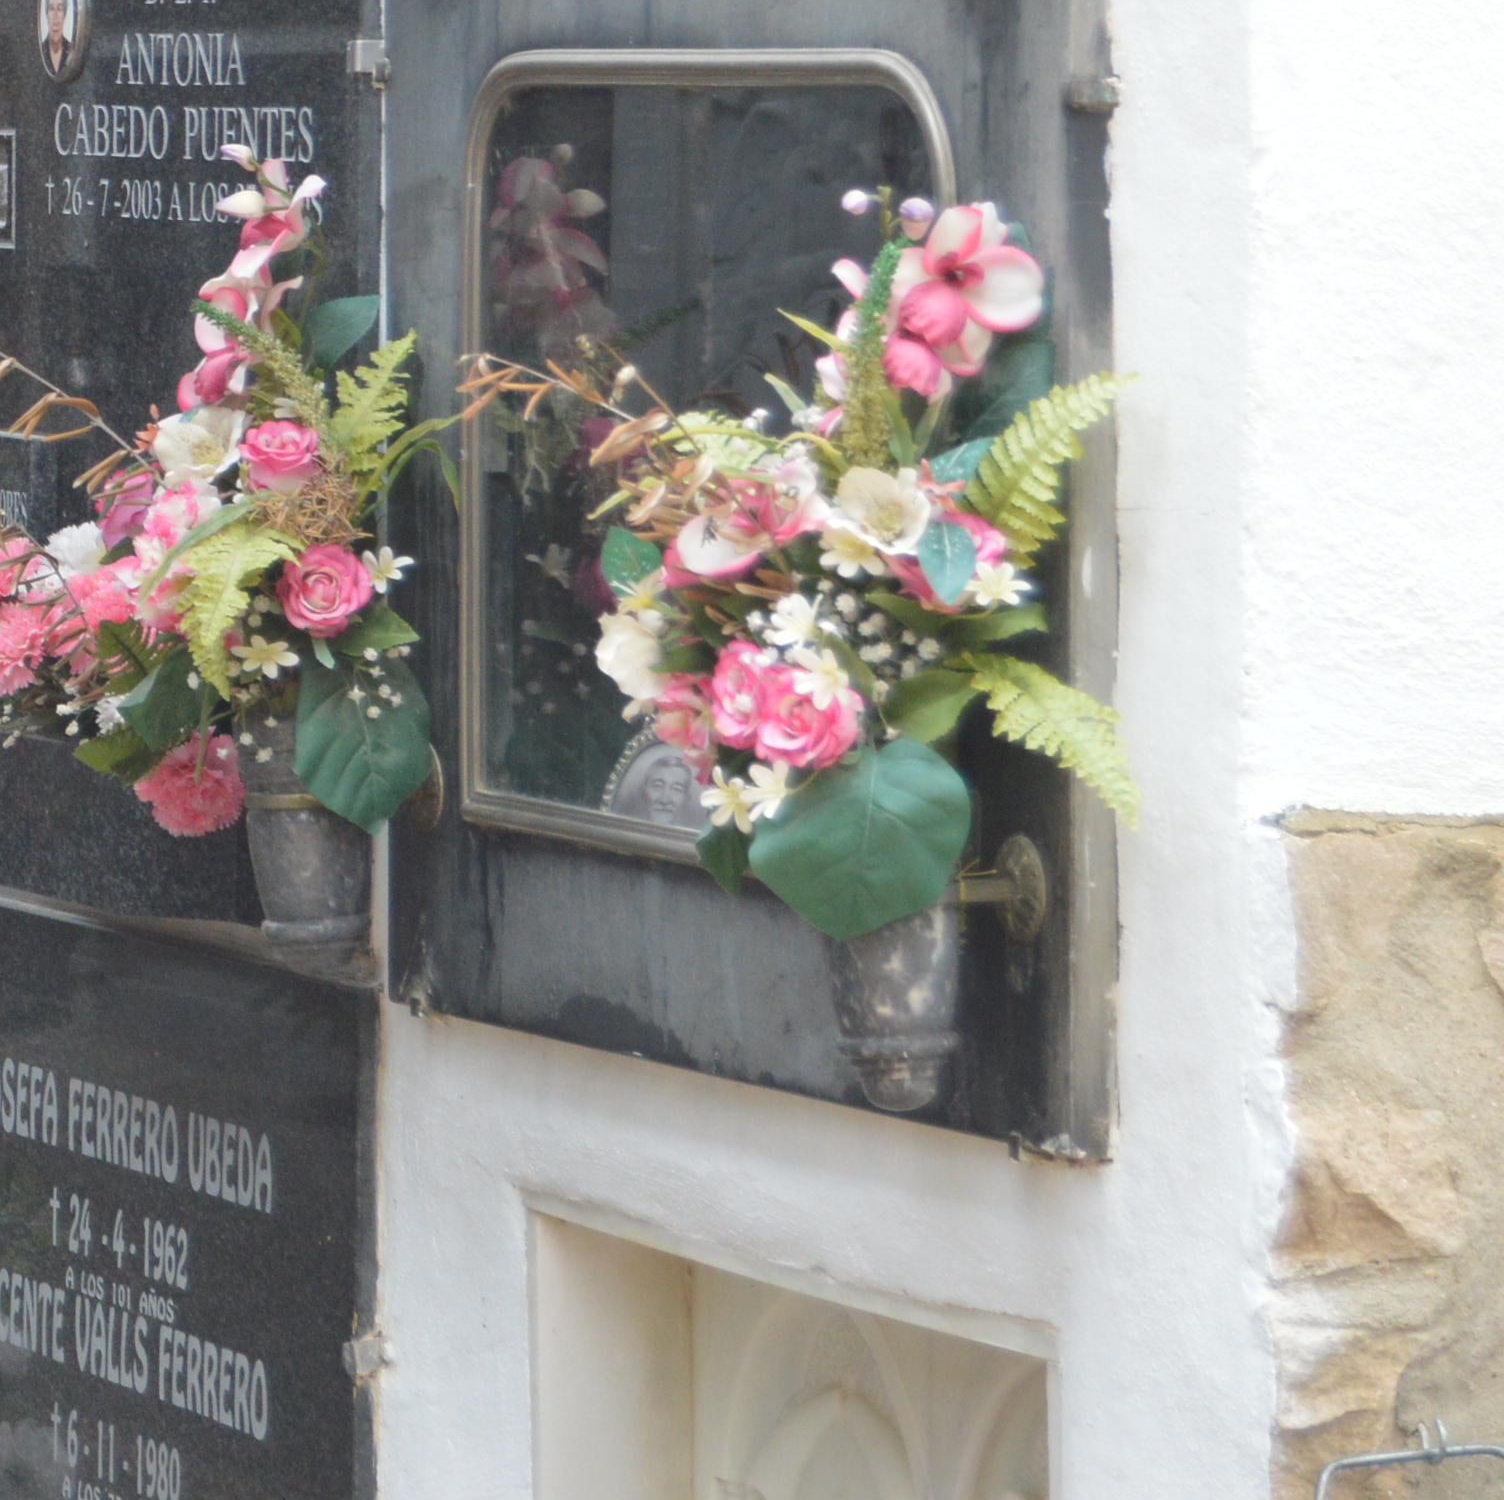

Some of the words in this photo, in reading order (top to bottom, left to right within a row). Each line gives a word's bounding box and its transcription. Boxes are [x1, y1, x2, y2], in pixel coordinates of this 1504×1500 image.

[116, 33, 245, 86] ANTONIA
[54, 103, 169, 160] CABEDO
[184, 107, 313, 163] PUENTES
[168, 182, 183, 221] A
[68, 1078, 180, 1184] FERRERO
[189, 1113, 273, 1215] UBEDA
[69, 1195, 91, 1257] 24
[143, 1218, 189, 1291] 1962
[65, 1267, 75, 1289] A
[81, 1269, 104, 1298] LOS
[112, 1283, 131, 1308] 101
[139, 1288, 175, 1322] AÑOS
[75, 1295, 148, 1395] VALLS
[158, 1325, 269, 1442] FERRERO
[136, 1434, 181, 1500] 1980
